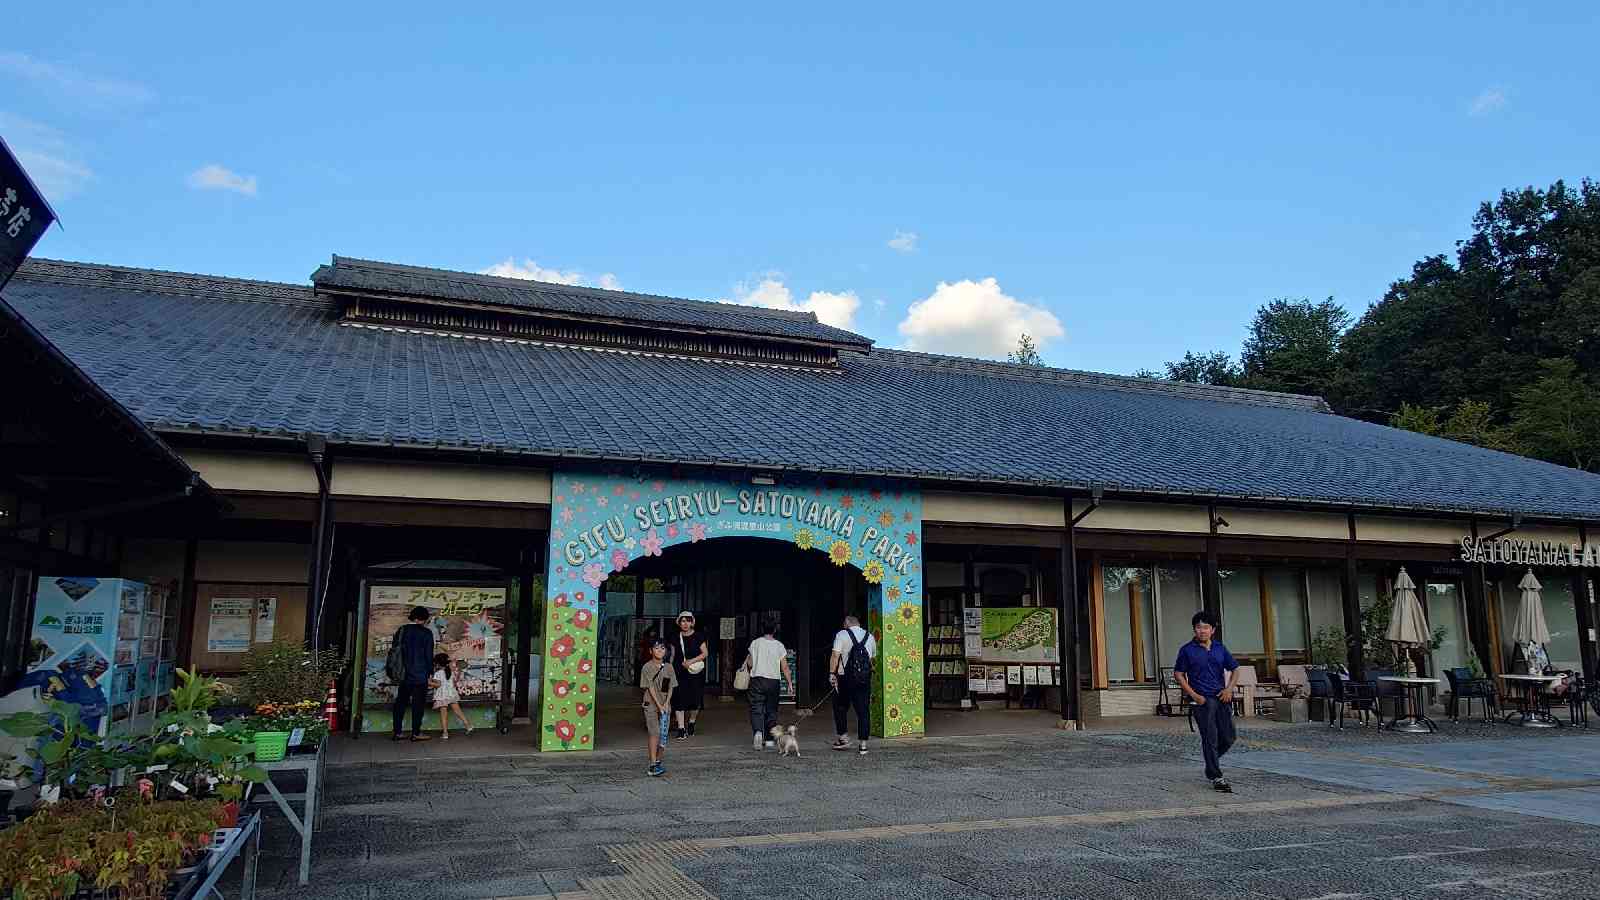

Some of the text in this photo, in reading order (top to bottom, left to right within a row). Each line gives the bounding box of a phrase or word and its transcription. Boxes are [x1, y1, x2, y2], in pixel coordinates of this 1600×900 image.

[563, 517, 627, 566] GIFU
[862, 525, 915, 576] PARK
[407, 590, 503, 603] アドベンチャー
[440, 602, 483, 616] パーク
